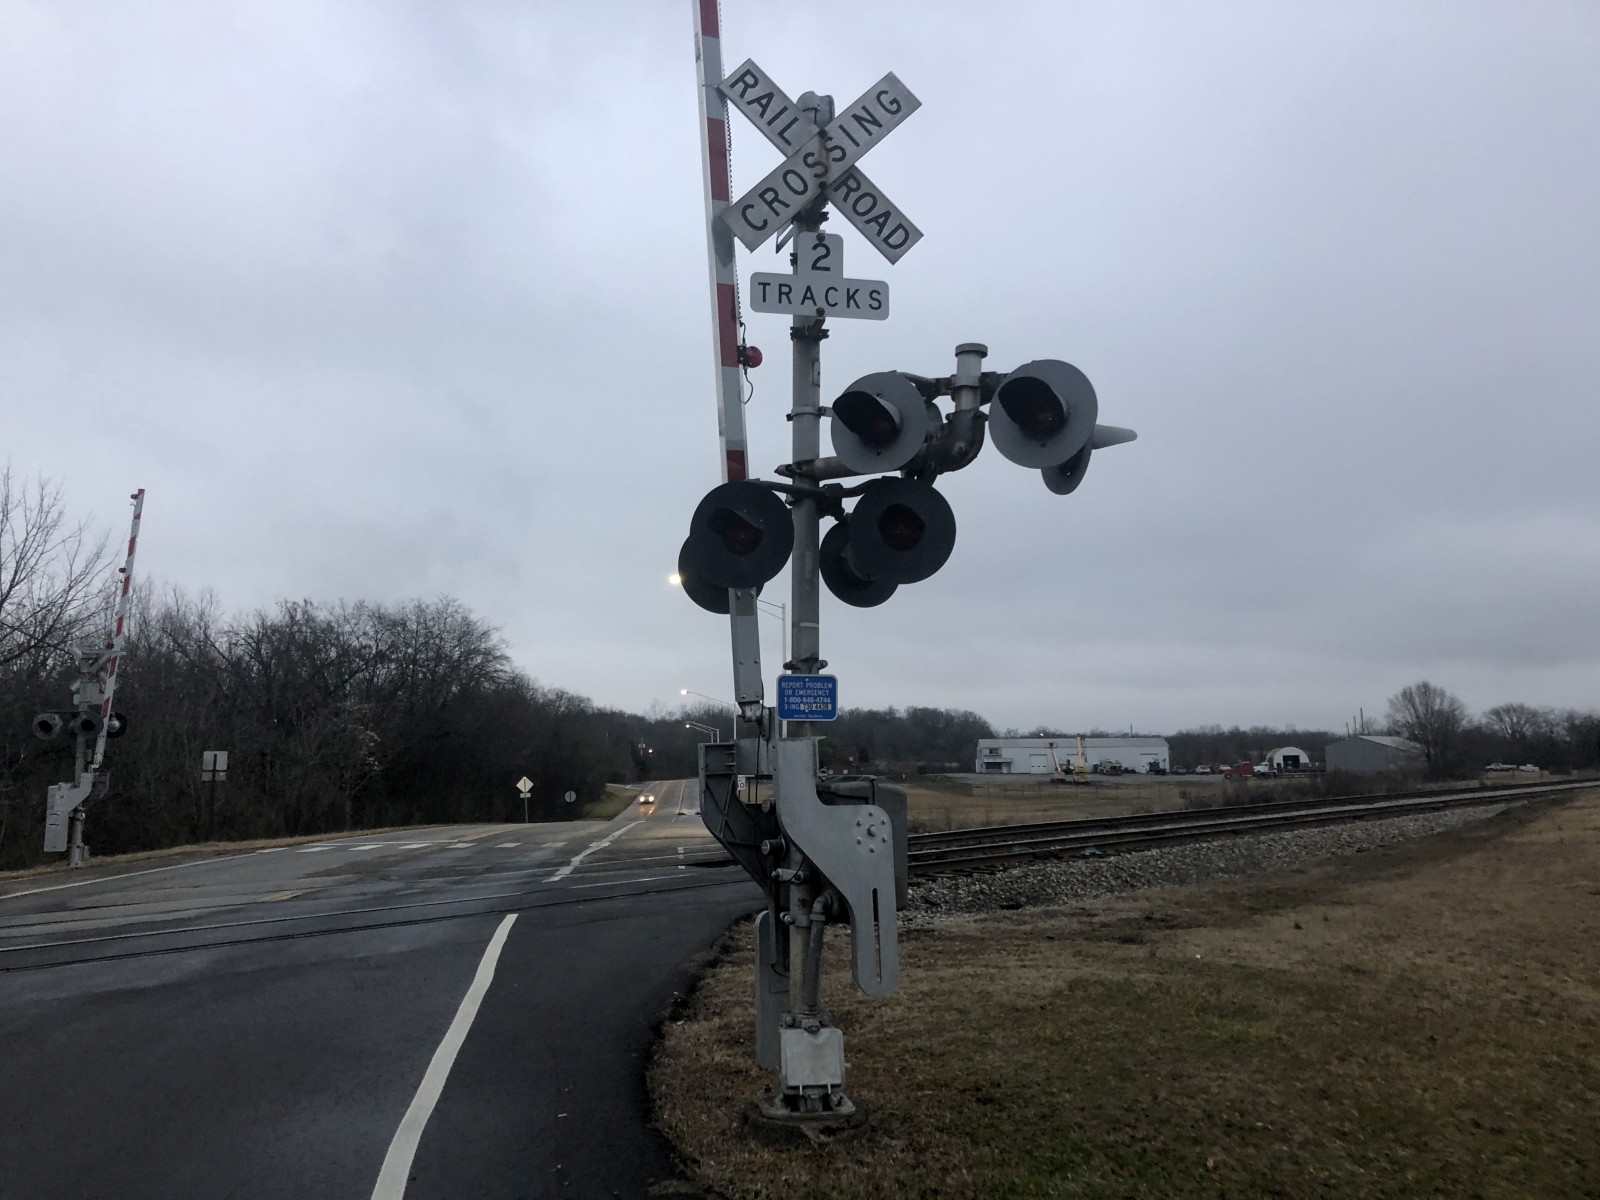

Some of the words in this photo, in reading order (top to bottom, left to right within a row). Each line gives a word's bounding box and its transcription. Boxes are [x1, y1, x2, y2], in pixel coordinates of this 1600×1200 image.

[729, 68, 800, 147] RAIL
[741, 89, 902, 232] CROSSING
[833, 173, 910, 250] ROAD
[811, 242, 831, 272] 2
[758, 281, 883, 311] TRACKS
